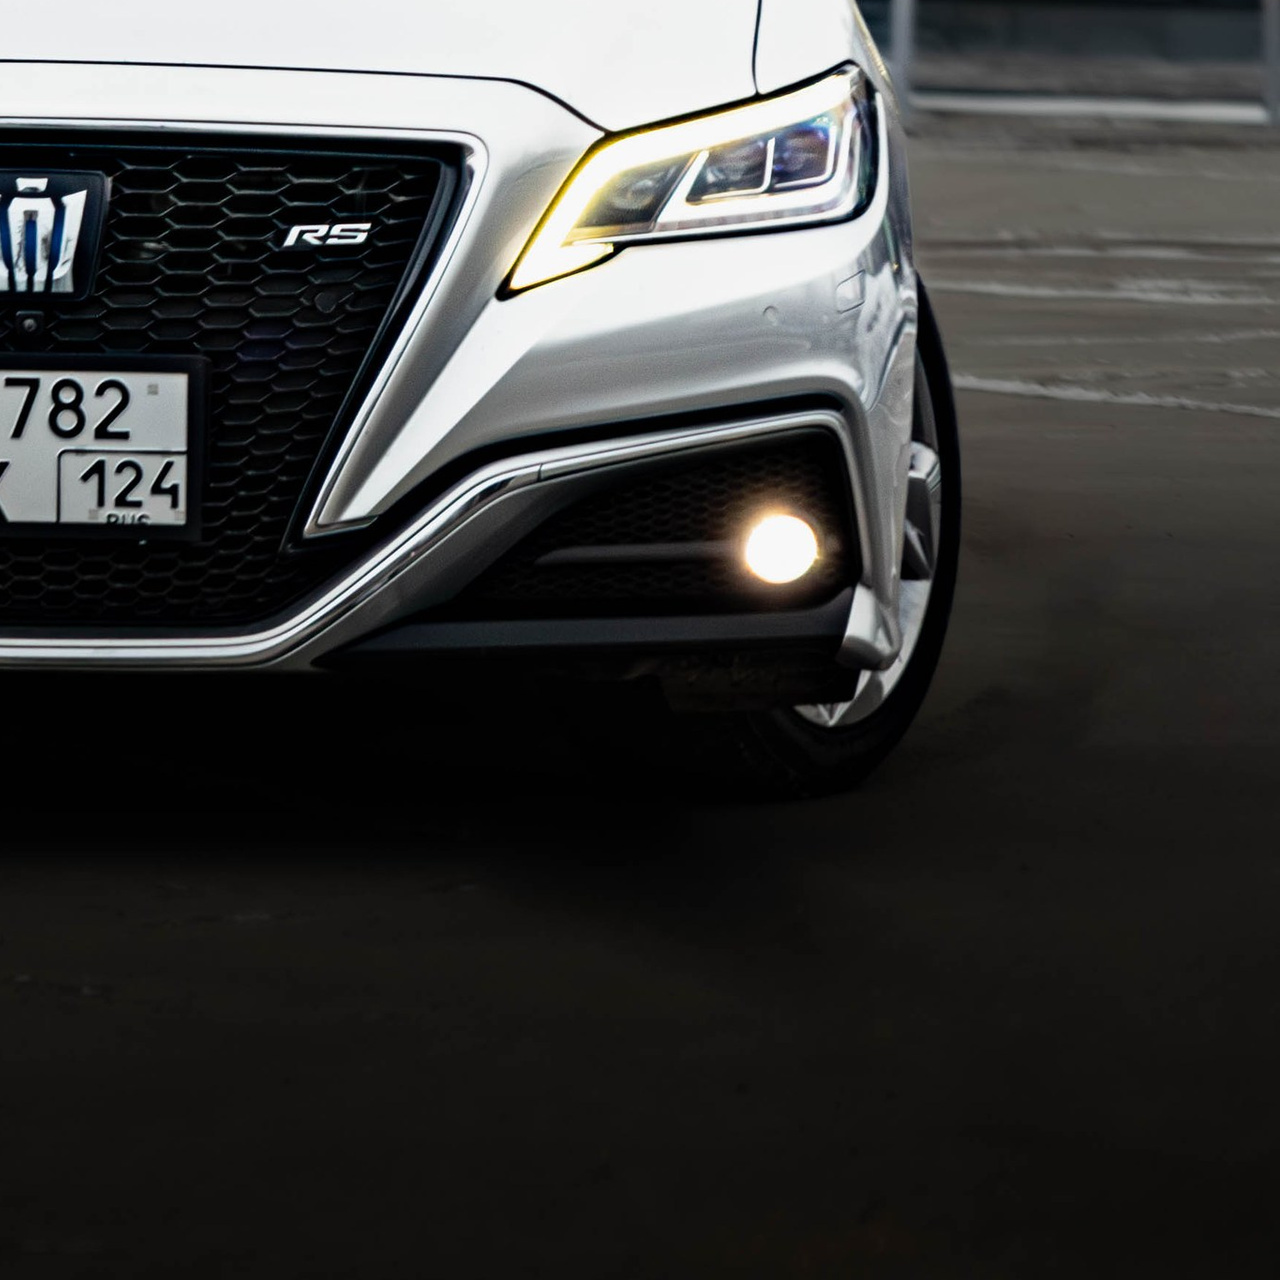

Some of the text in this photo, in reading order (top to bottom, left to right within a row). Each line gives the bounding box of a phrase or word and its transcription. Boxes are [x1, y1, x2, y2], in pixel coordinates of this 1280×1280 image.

[282, 222, 372, 248] RS
[3, 376, 131, 441] 782
[79, 458, 180, 509] 124
